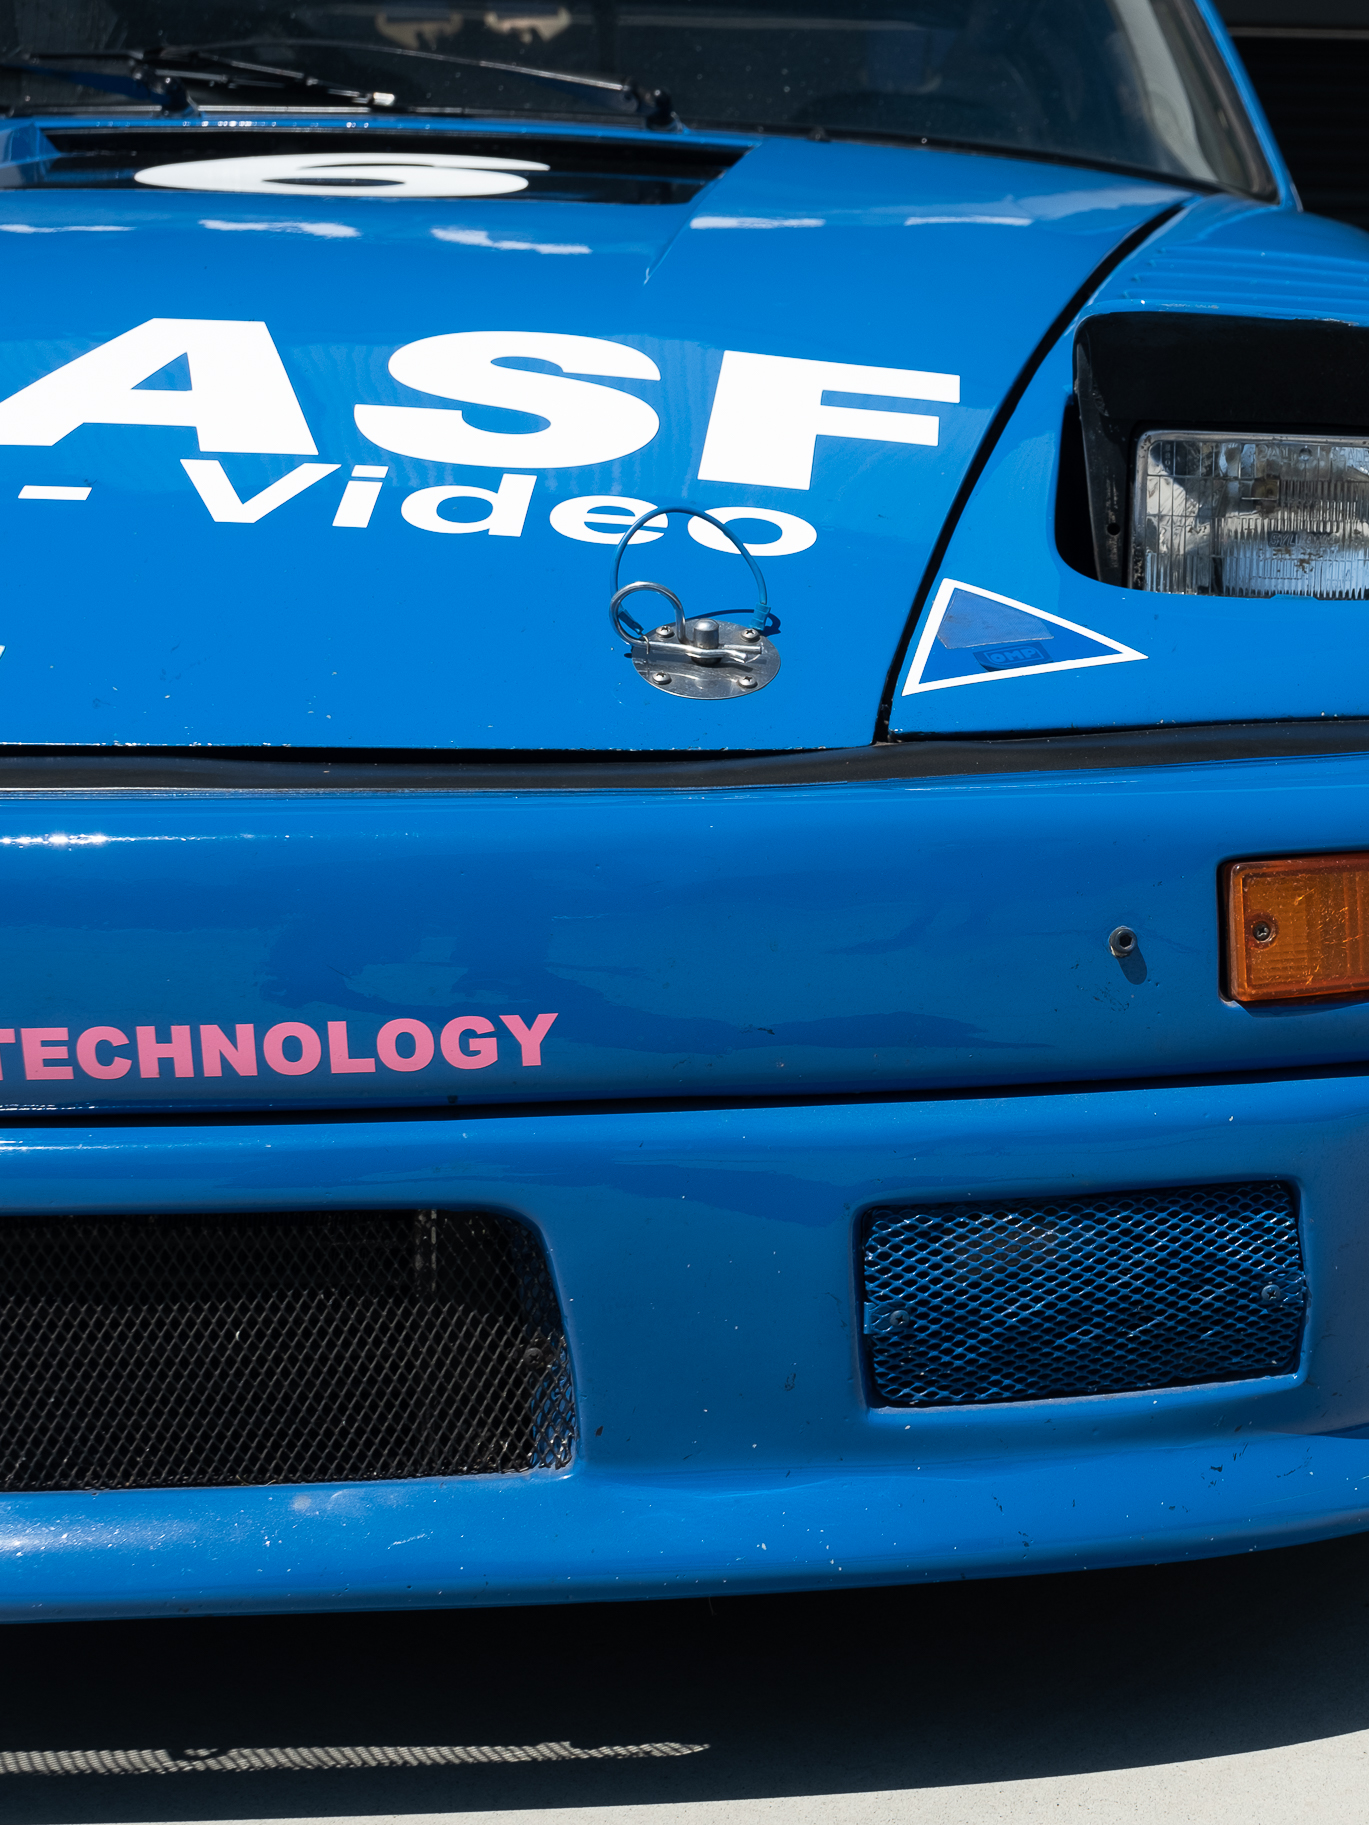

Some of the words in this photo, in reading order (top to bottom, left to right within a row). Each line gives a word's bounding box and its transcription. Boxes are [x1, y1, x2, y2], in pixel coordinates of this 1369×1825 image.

[135, 153, 551, 197] 6
[0, 318, 960, 488] ASF
[180, 459, 817, 557] Video
[990, 648, 1036, 662] OMP
[0, 1014, 558, 1080] ECHNOLOGY
